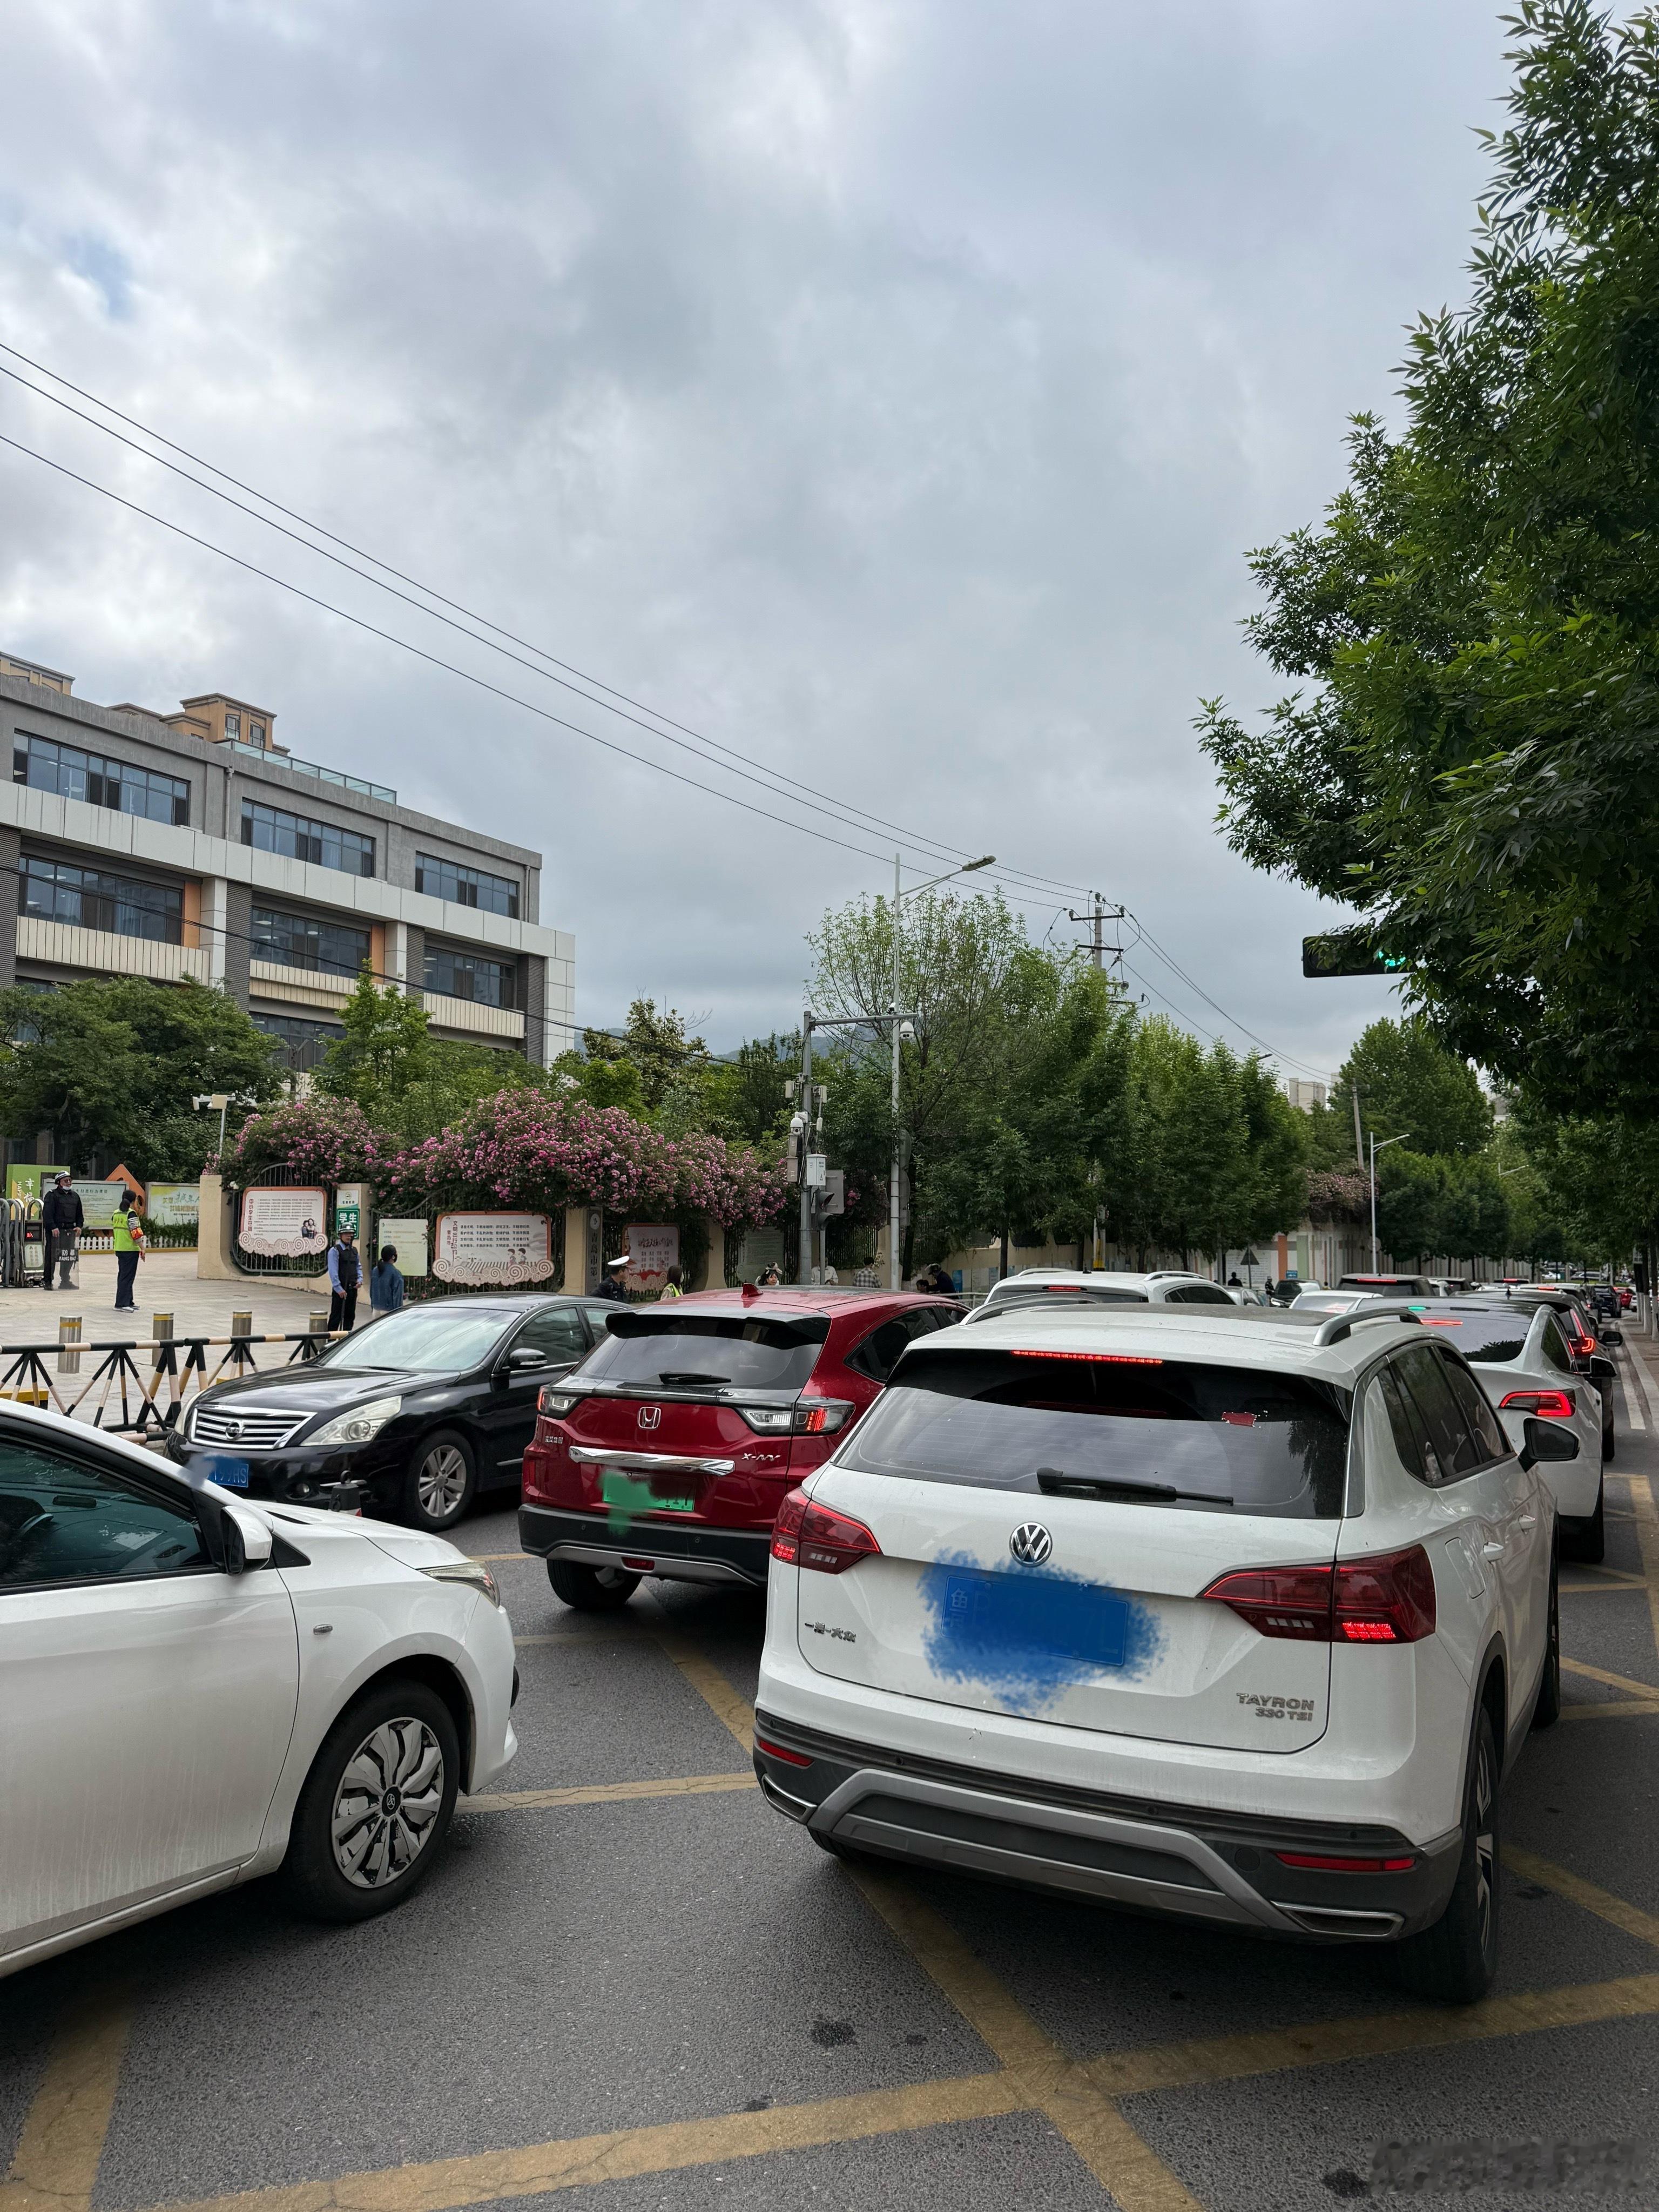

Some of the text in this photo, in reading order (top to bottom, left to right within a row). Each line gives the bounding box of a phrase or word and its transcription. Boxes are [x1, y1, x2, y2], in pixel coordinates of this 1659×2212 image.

[339, 1212, 357, 1223] 学生
[1236, 1692, 1314, 1711] TAYRON
[1255, 1707, 1313, 1721] 330 TSI
